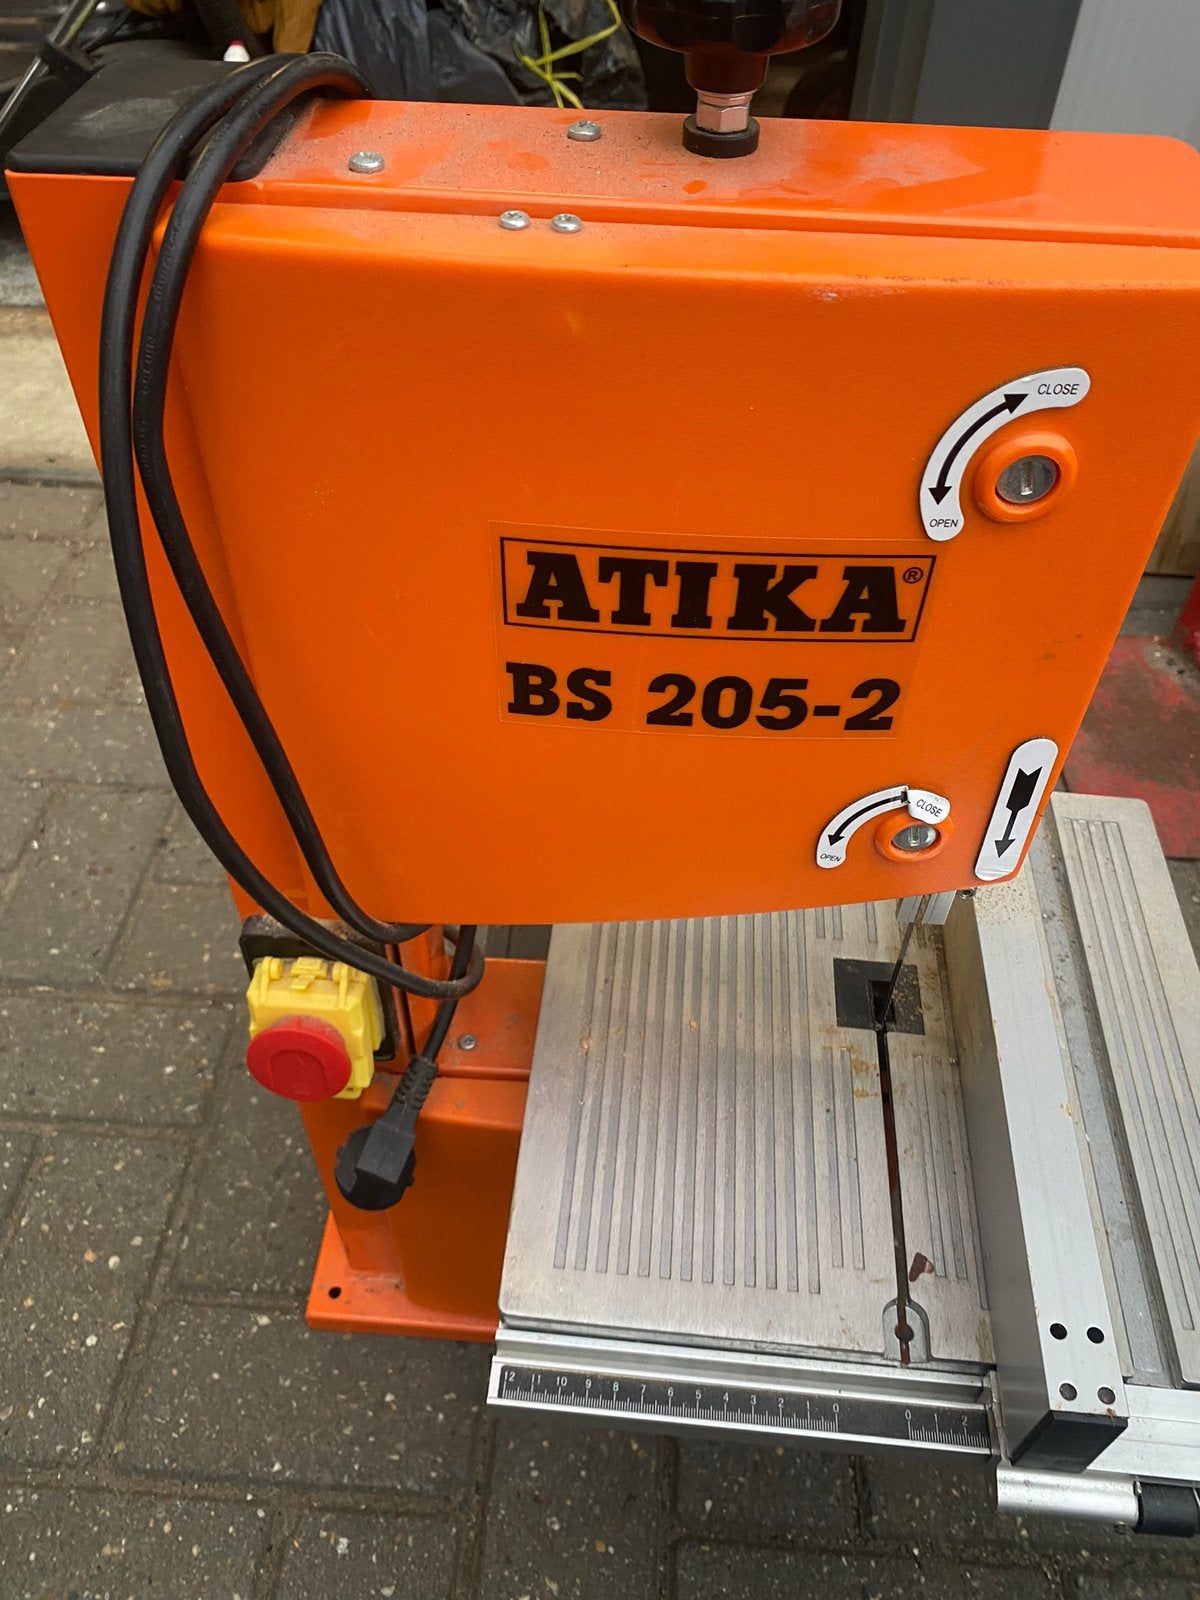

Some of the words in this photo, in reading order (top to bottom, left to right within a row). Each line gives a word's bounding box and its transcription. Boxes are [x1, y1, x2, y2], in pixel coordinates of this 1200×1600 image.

[1037, 383, 1080, 395] CLOSE
[929, 518, 959, 528] OPEN
[505, 661, 613, 722] BS
[646, 672, 901, 731] 205-2
[916, 798, 943, 818] CLOSE
[819, 852, 842, 862] OPEN
[504, 1370, 516, 1382] 12
[556, 1375, 568, 1387] 10
[585, 1378, 592, 1389] 9
[612, 1381, 619, 1392] 8
[640, 1384, 646, 1394] 7
[667, 1387, 674, 1397] 6
[695, 1389, 702, 1400] 5
[722, 1392, 729, 1402] 4
[750, 1394, 757, 1405] 3
[778, 1397, 784, 1408] 2
[832, 1402, 839, 1413] 0
[905, 1409, 911, 1420] 0
[962, 1415, 967, 1426] 2
